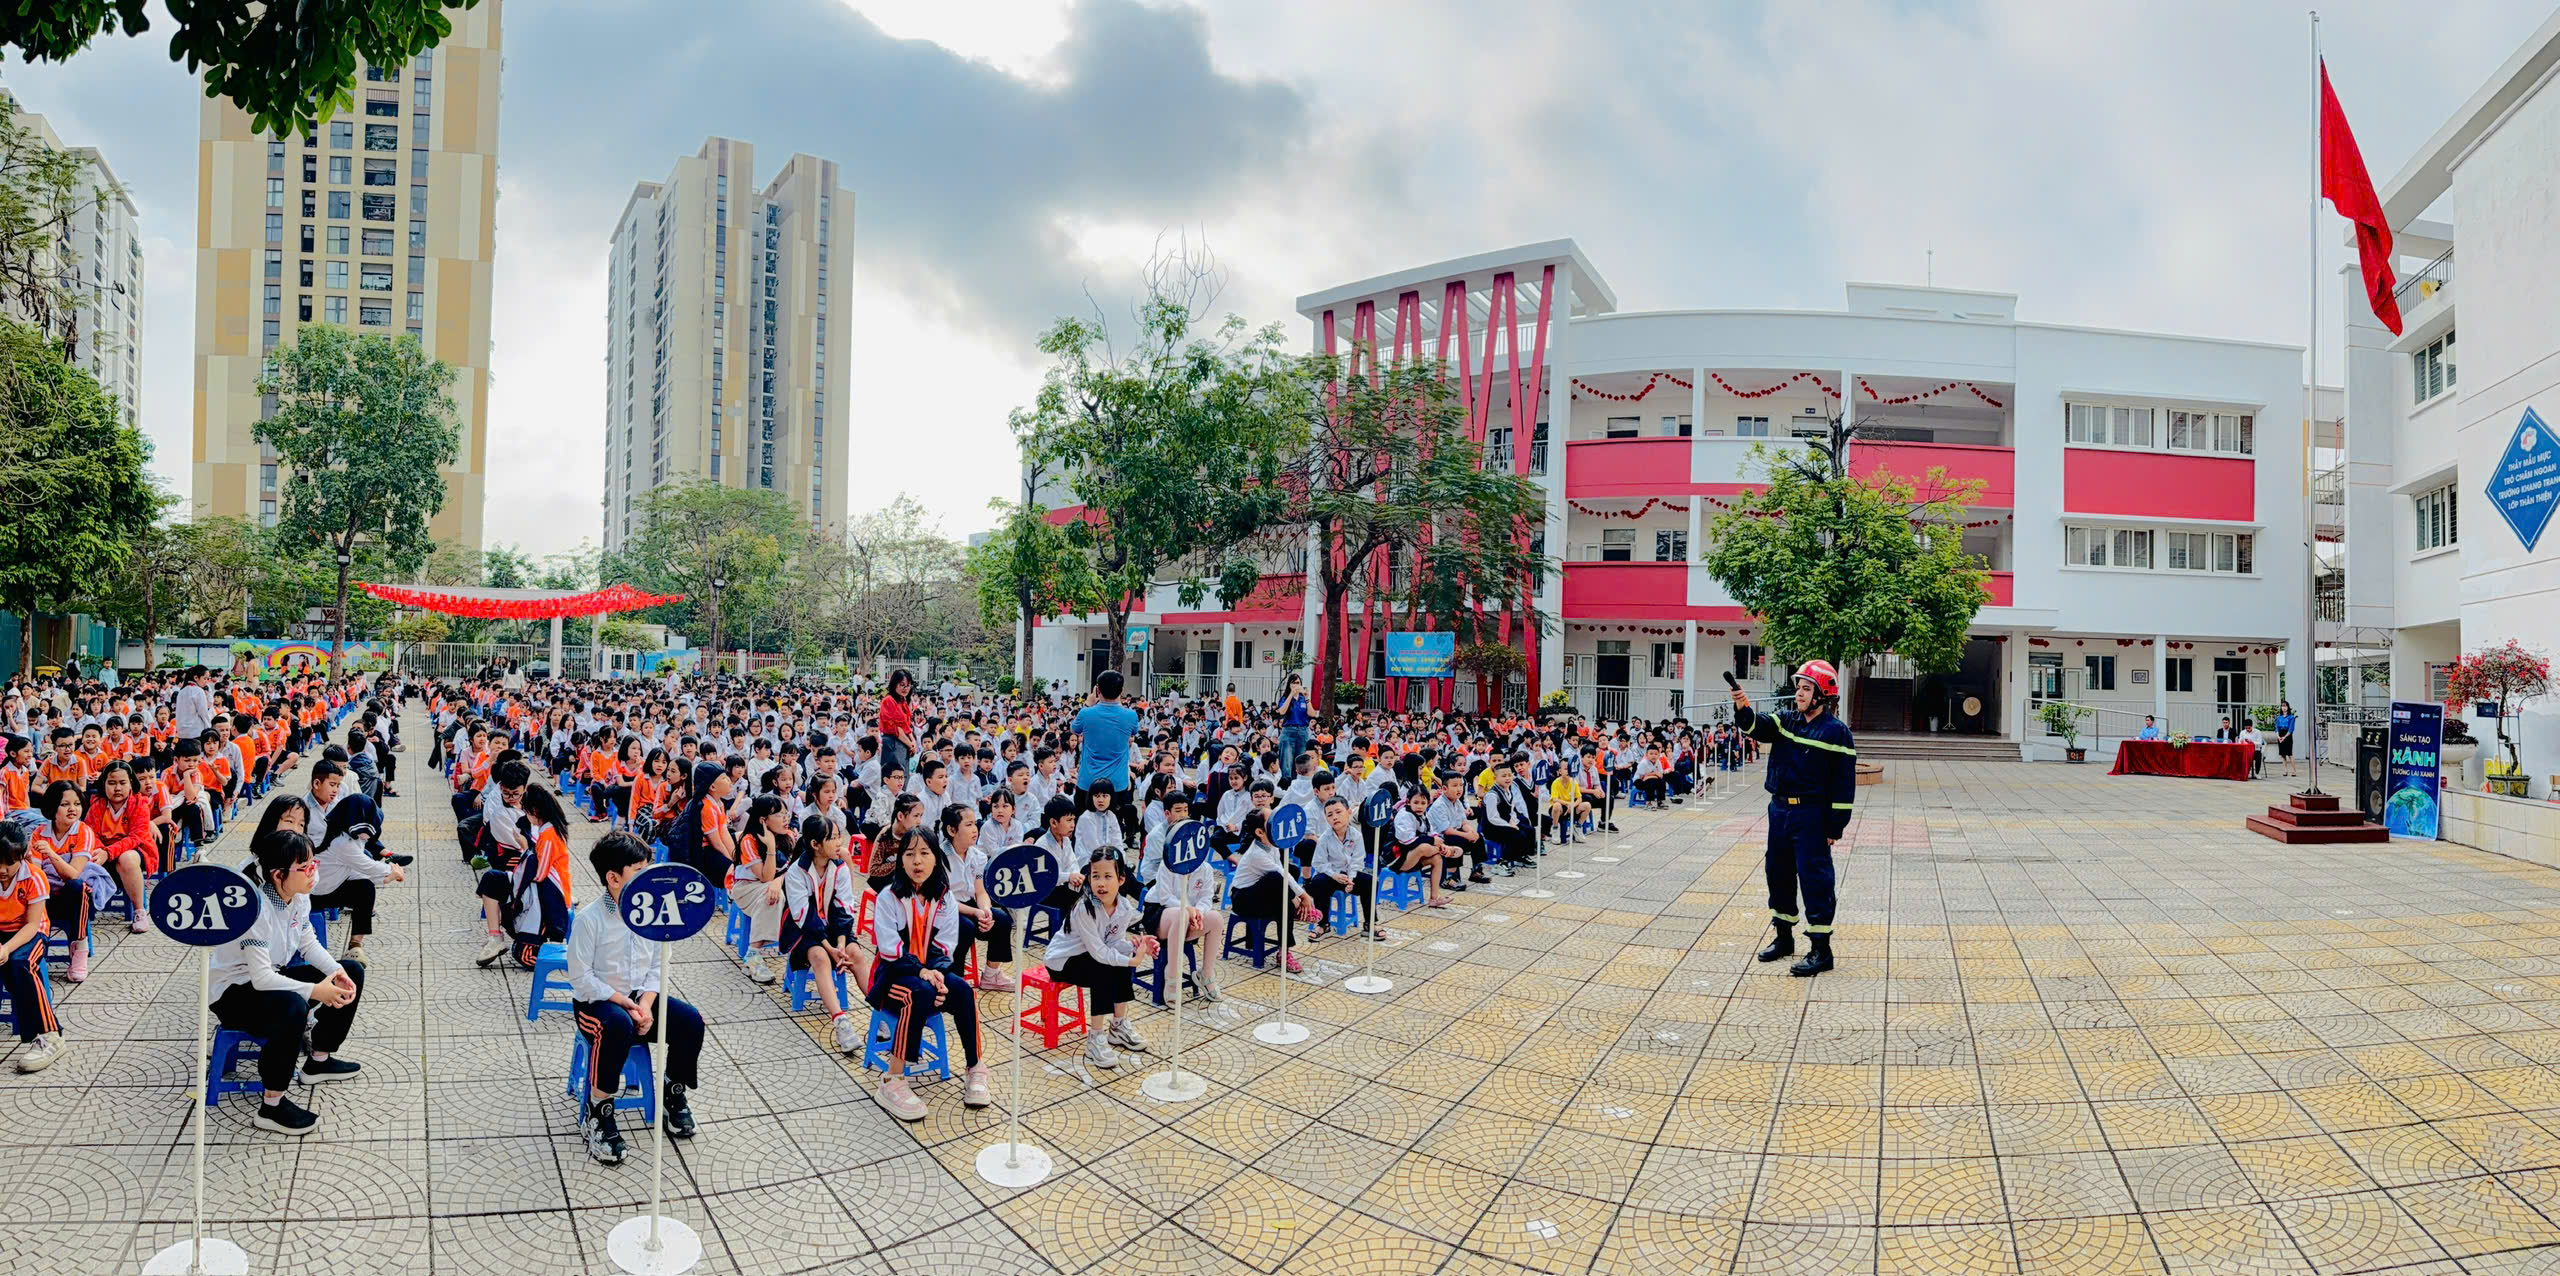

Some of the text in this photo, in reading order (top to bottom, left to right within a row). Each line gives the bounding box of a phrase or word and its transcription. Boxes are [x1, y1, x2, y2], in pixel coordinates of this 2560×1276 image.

[2521, 480, 2543, 493] KHANG
[2533, 462, 2557, 477] NGOAN
[2400, 733, 2431, 746] SÁNG TẠO
[1276, 812, 1302, 841] 1A5
[1173, 826, 1206, 865] 1A6
[993, 854, 1049, 898] 3A1
[166, 885, 248, 930] 3A3
[629, 881, 706, 927] 3A2
